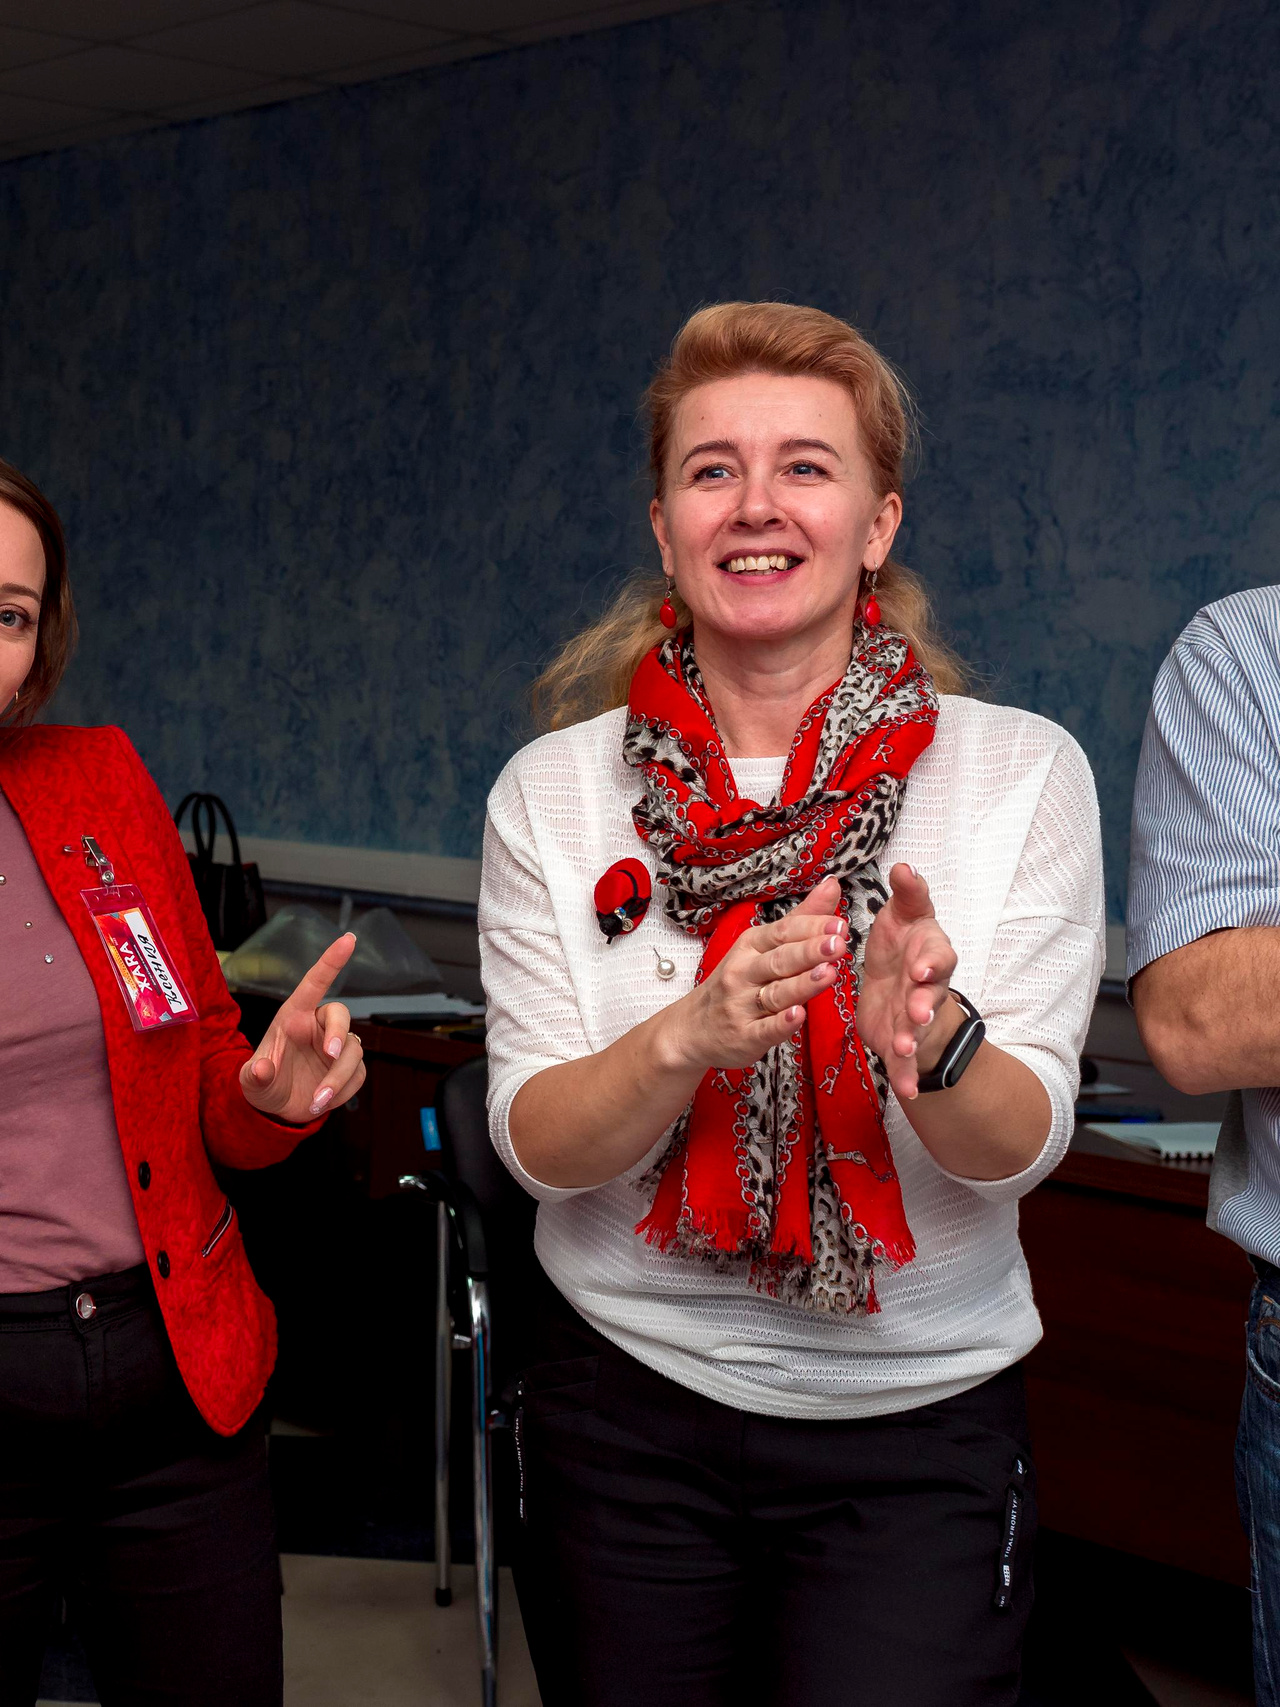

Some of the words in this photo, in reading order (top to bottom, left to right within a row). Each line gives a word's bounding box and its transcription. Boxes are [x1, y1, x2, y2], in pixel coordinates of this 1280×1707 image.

[870, 743, 894, 763] R
[137, 934, 182, 1005] Ксения
[1004, 1537, 1014, 1558] TIDAL
[1009, 1510, 1017, 1536] FRONT
